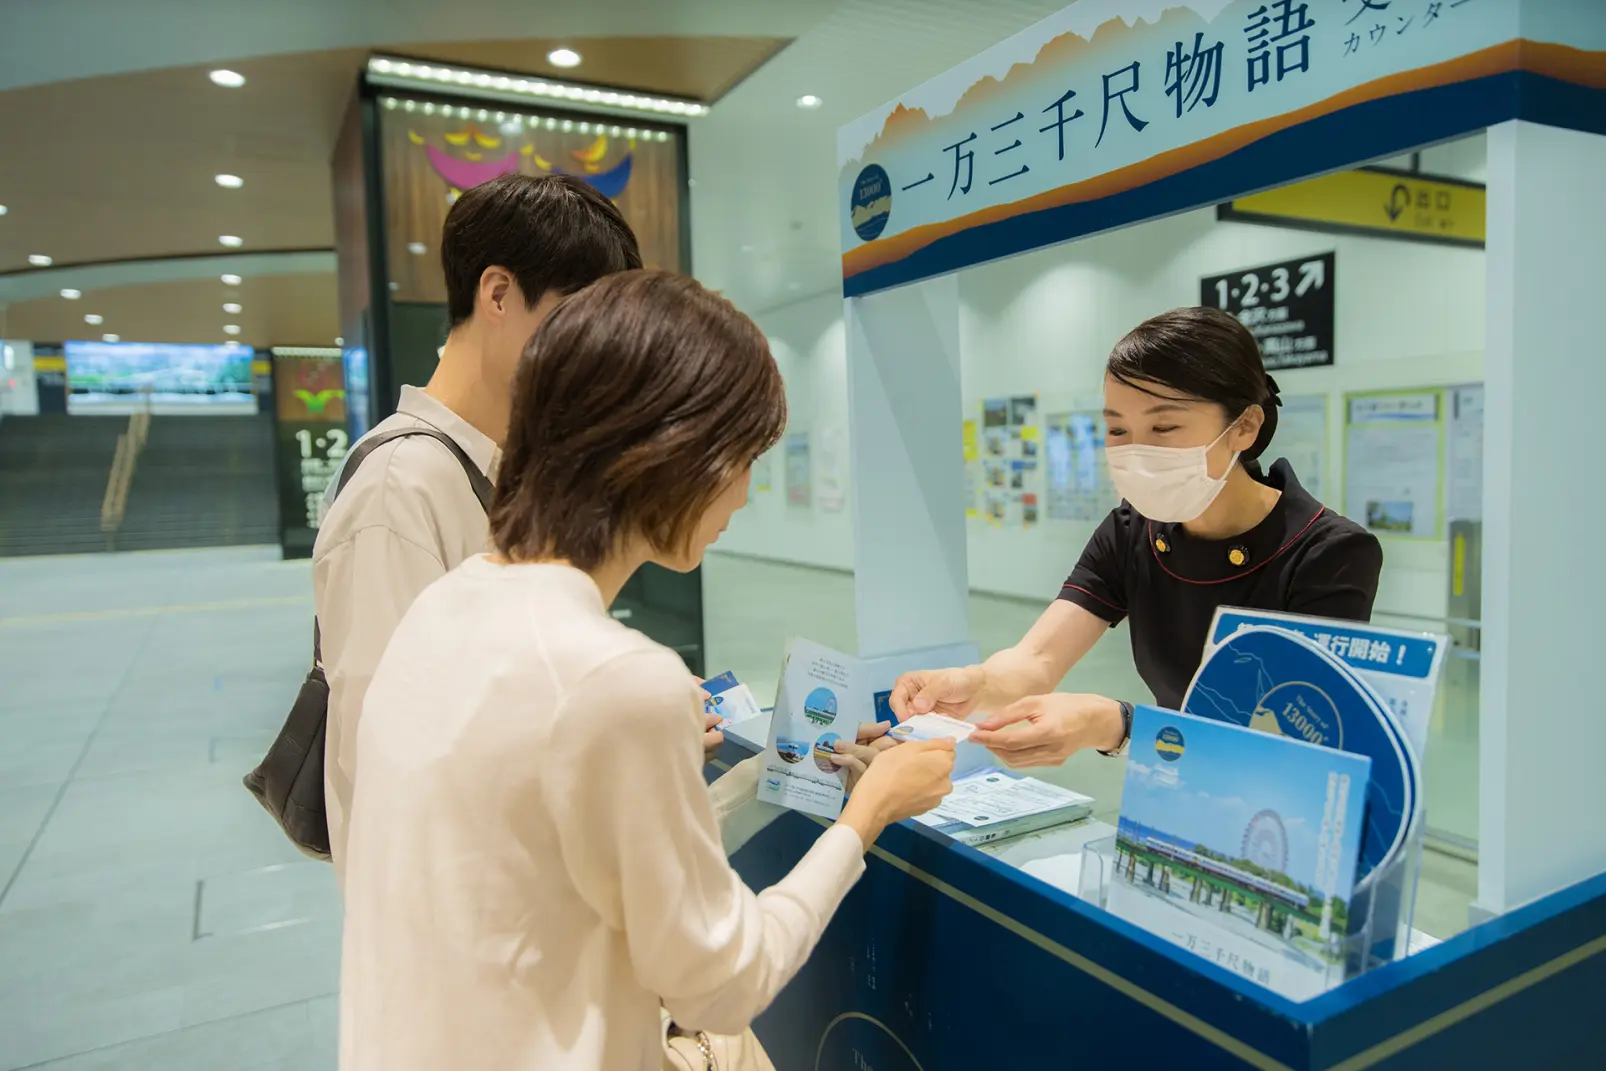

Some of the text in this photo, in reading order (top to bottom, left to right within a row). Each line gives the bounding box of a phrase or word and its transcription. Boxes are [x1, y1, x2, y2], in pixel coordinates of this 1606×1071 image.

[902, 0, 1316, 200] 一万三千尺物語
